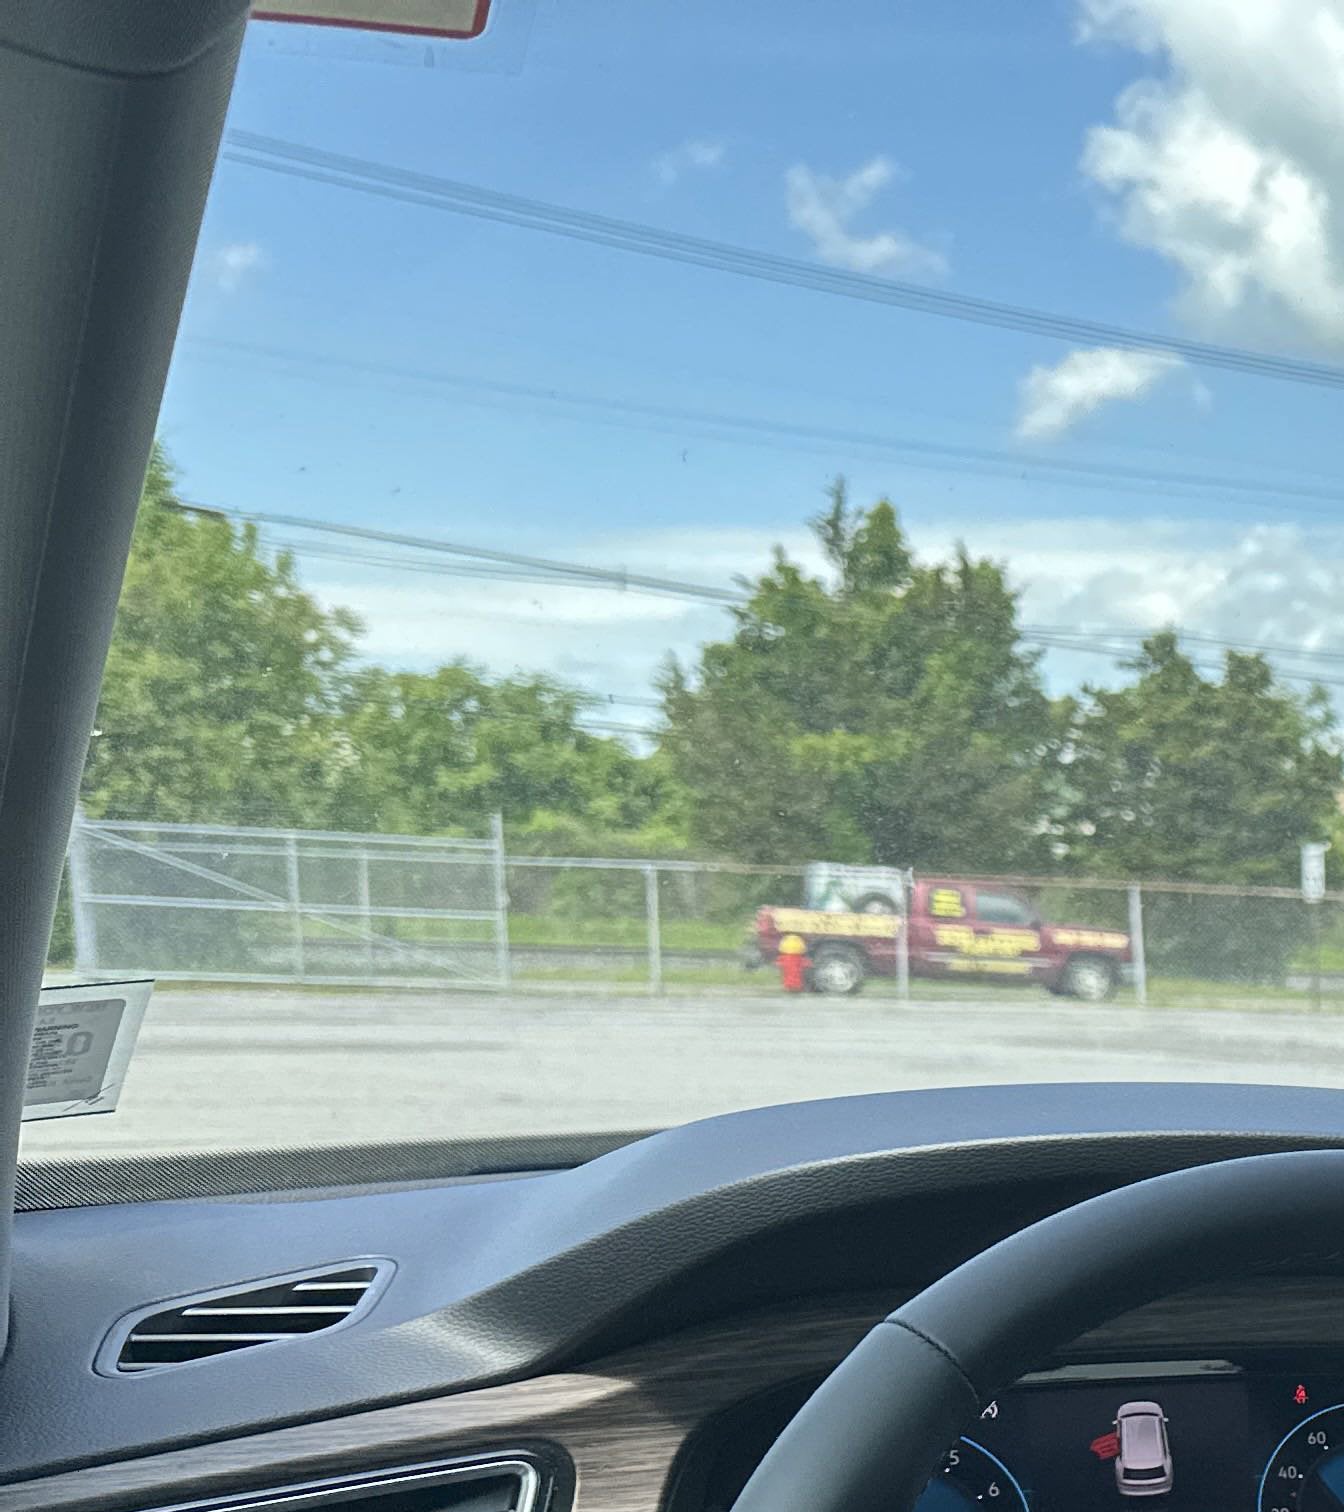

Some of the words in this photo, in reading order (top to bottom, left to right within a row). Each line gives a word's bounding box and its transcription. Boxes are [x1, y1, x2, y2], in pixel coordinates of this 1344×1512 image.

[1307, 1431, 1326, 1445] 60
[949, 1450, 960, 1465] 5
[1278, 1465, 1297, 1479] 40
[988, 1482, 1000, 1497] 6
